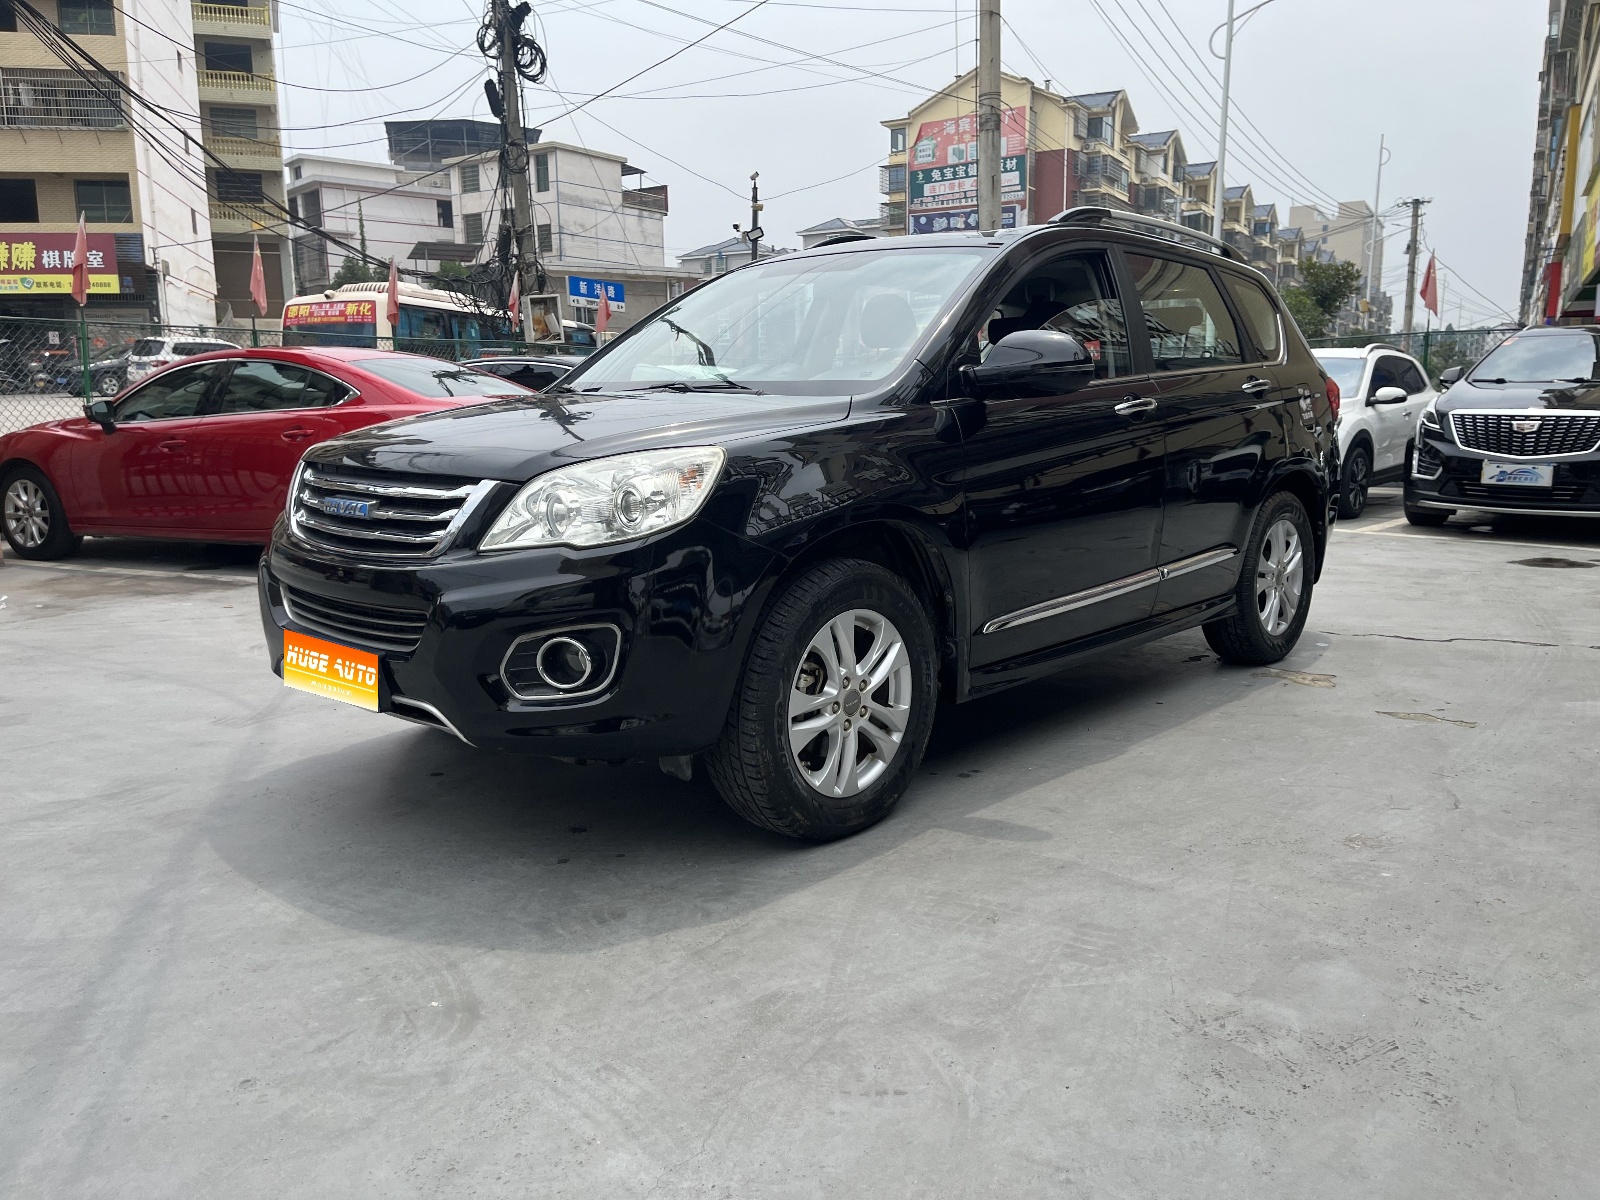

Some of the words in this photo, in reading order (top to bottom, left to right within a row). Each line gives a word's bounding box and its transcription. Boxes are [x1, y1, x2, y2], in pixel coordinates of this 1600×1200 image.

[931, 157, 1017, 182] 兔宝宝健材
[345, 303, 371, 315] 新化
[324, 500, 366, 516] HAVAL
